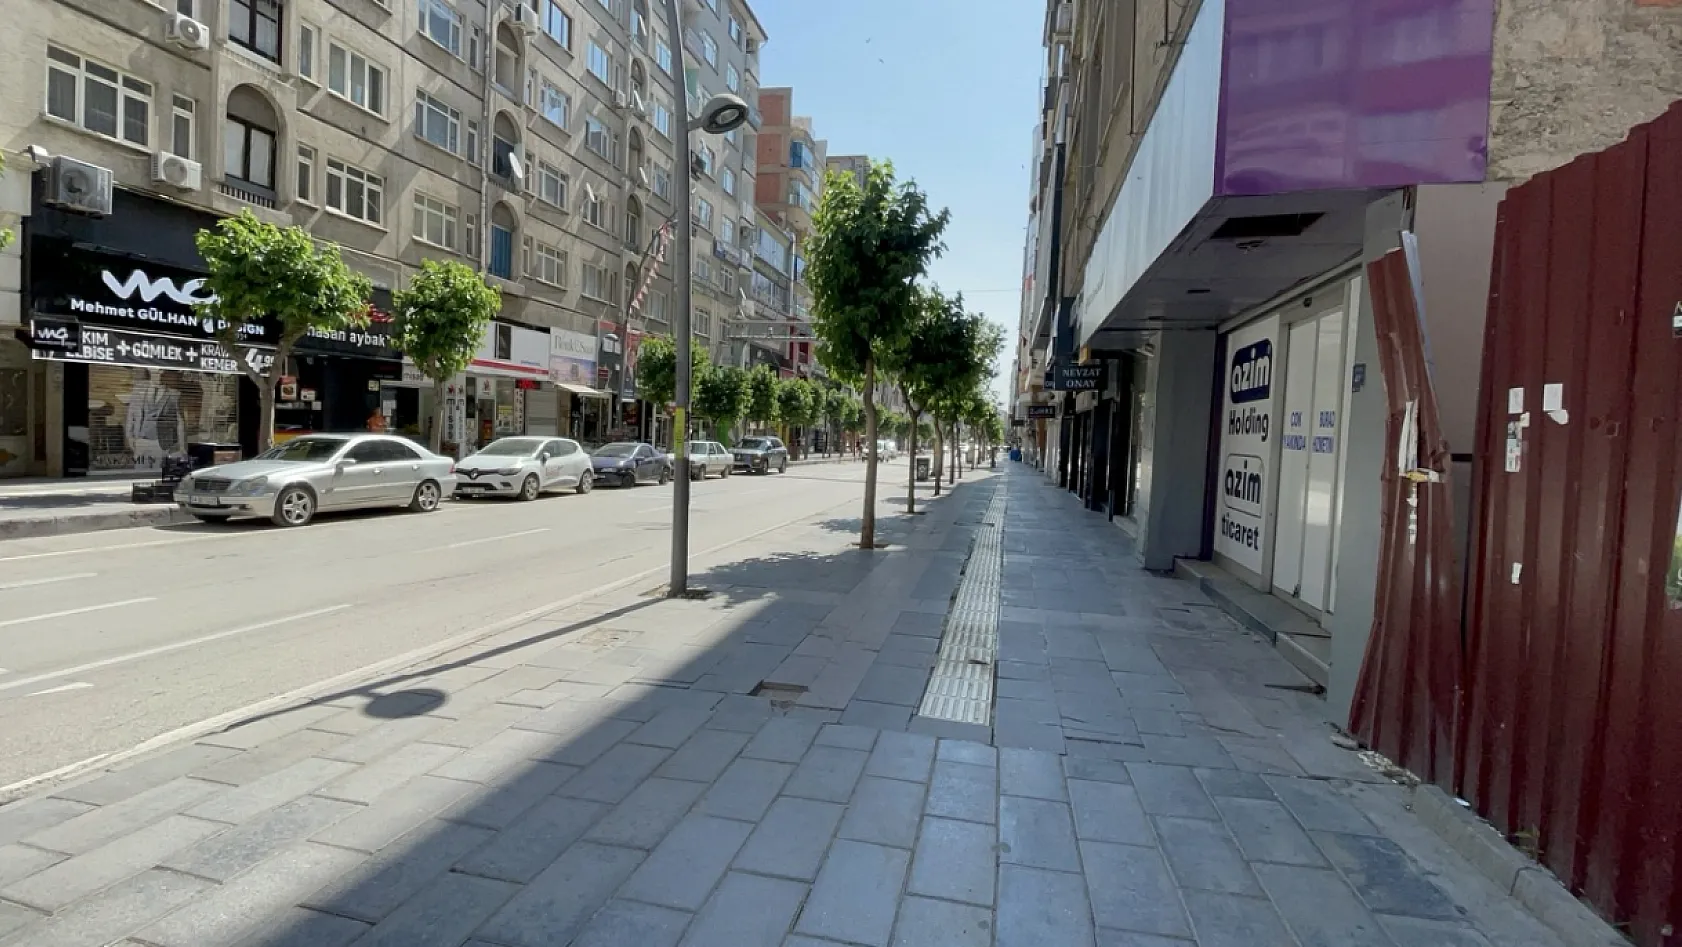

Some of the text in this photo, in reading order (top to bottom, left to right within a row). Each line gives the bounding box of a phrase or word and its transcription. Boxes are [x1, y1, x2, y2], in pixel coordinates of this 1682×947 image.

[71, 298, 135, 318] Mehmet
[137, 307, 198, 327] GÜLHAN
[306, 322, 385, 348] hasan aybak
[132, 340, 182, 361] GÖMLEK
[200, 357, 239, 371] KEMER
[1062, 368, 1102, 378] NEVZAT
[1065, 379, 1097, 388] ONAY
[1231, 347, 1272, 393] azim
[1228, 407, 1269, 443] Holding
[1224, 459, 1262, 504] azim
[1221, 513, 1260, 551] ticaret
